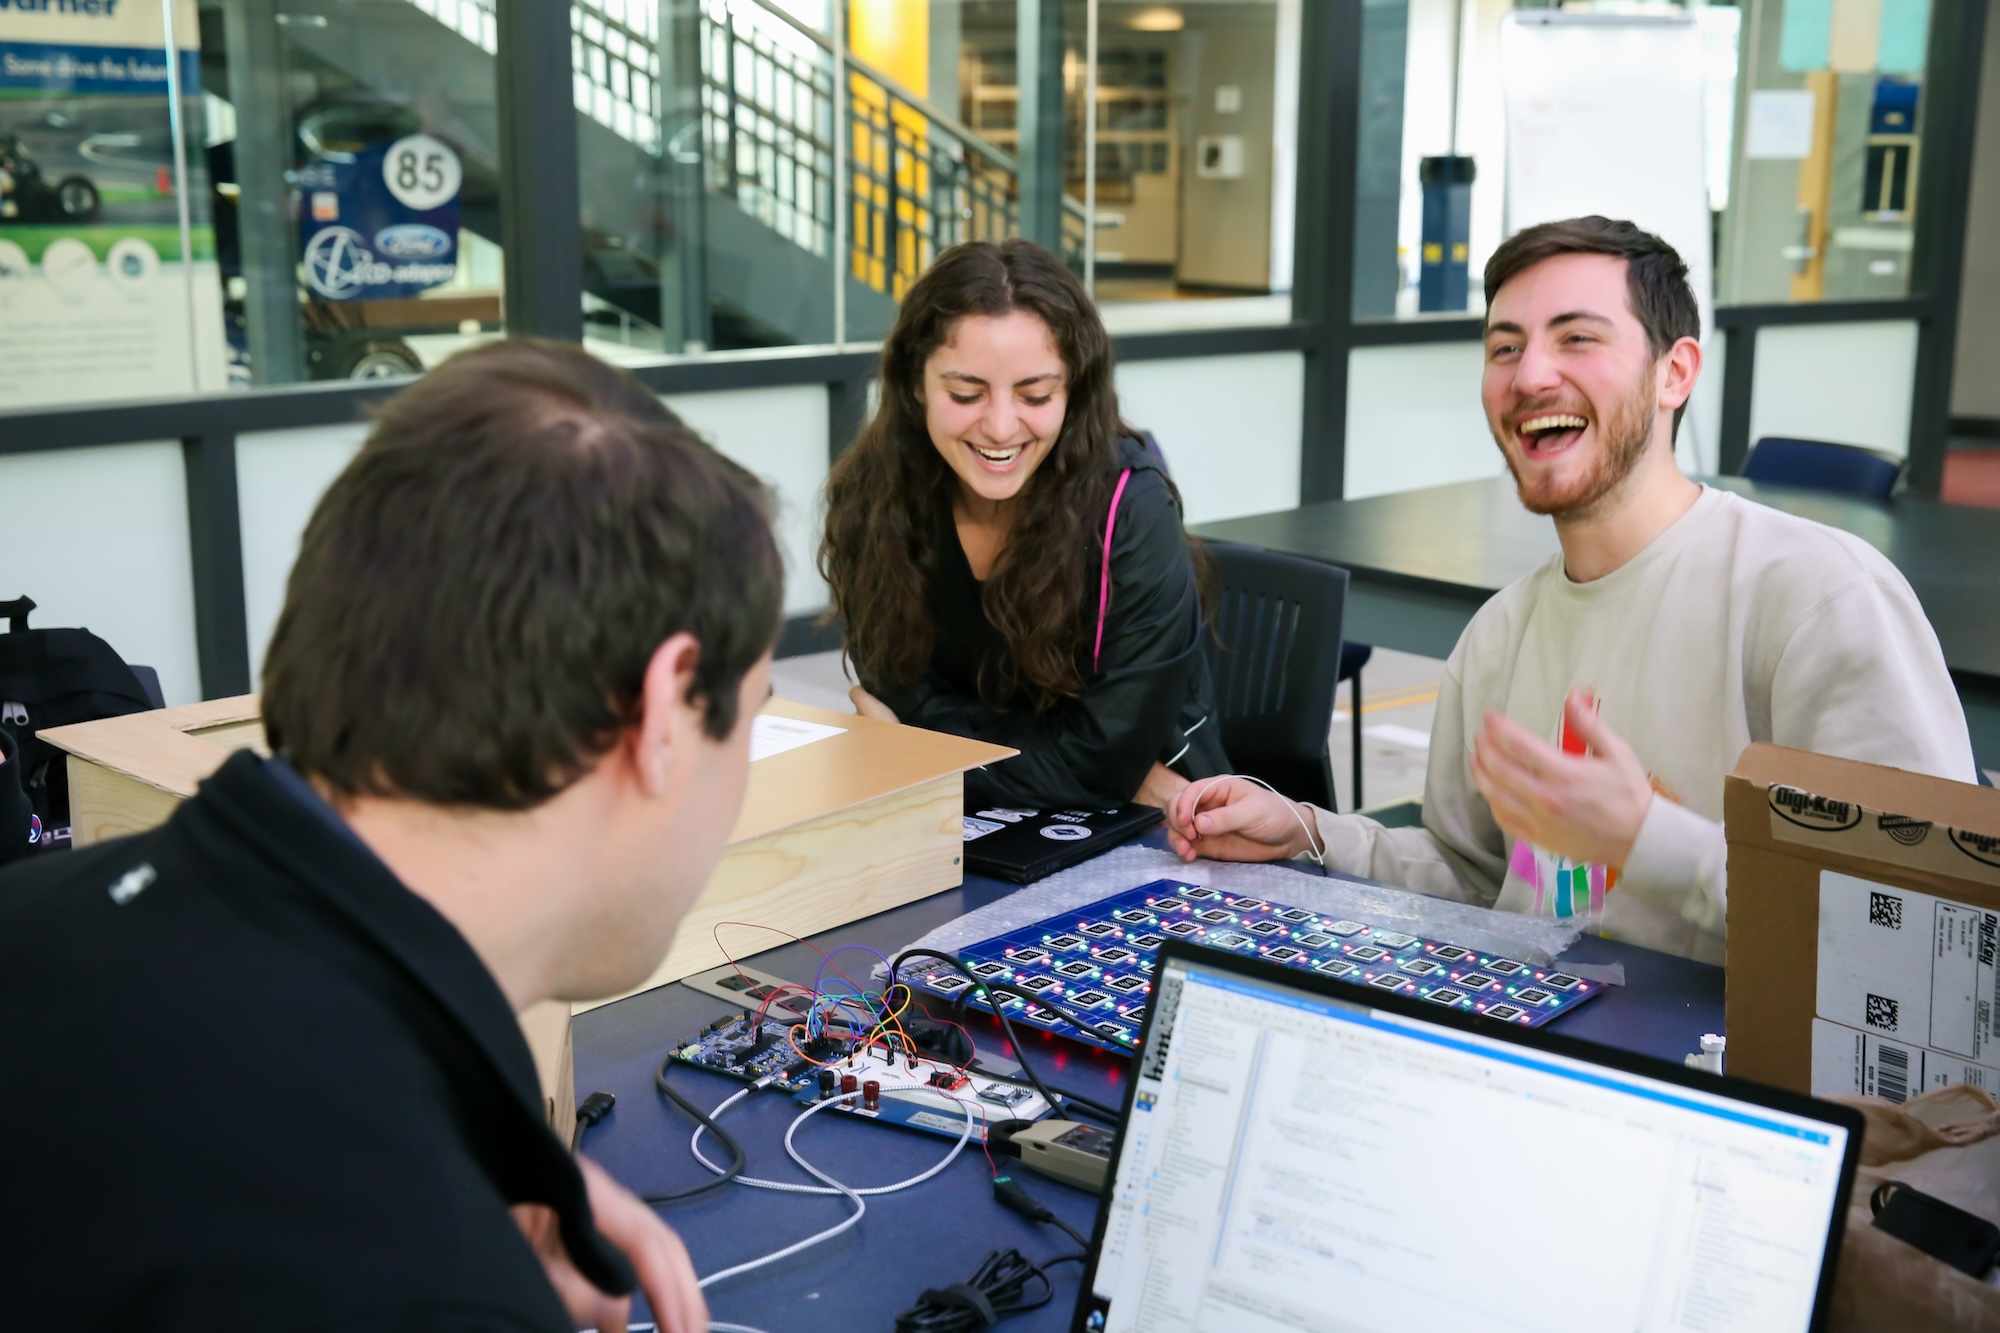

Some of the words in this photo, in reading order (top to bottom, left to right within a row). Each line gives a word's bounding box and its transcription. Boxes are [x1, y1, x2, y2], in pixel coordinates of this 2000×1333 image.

[0, 0, 116, 16] arner
[127, 56, 168, 81] futur
[398, 151, 444, 192] 85
[1050, 814, 1086, 823] FIRST
[1979, 912, 1998, 967] Digi-Key
